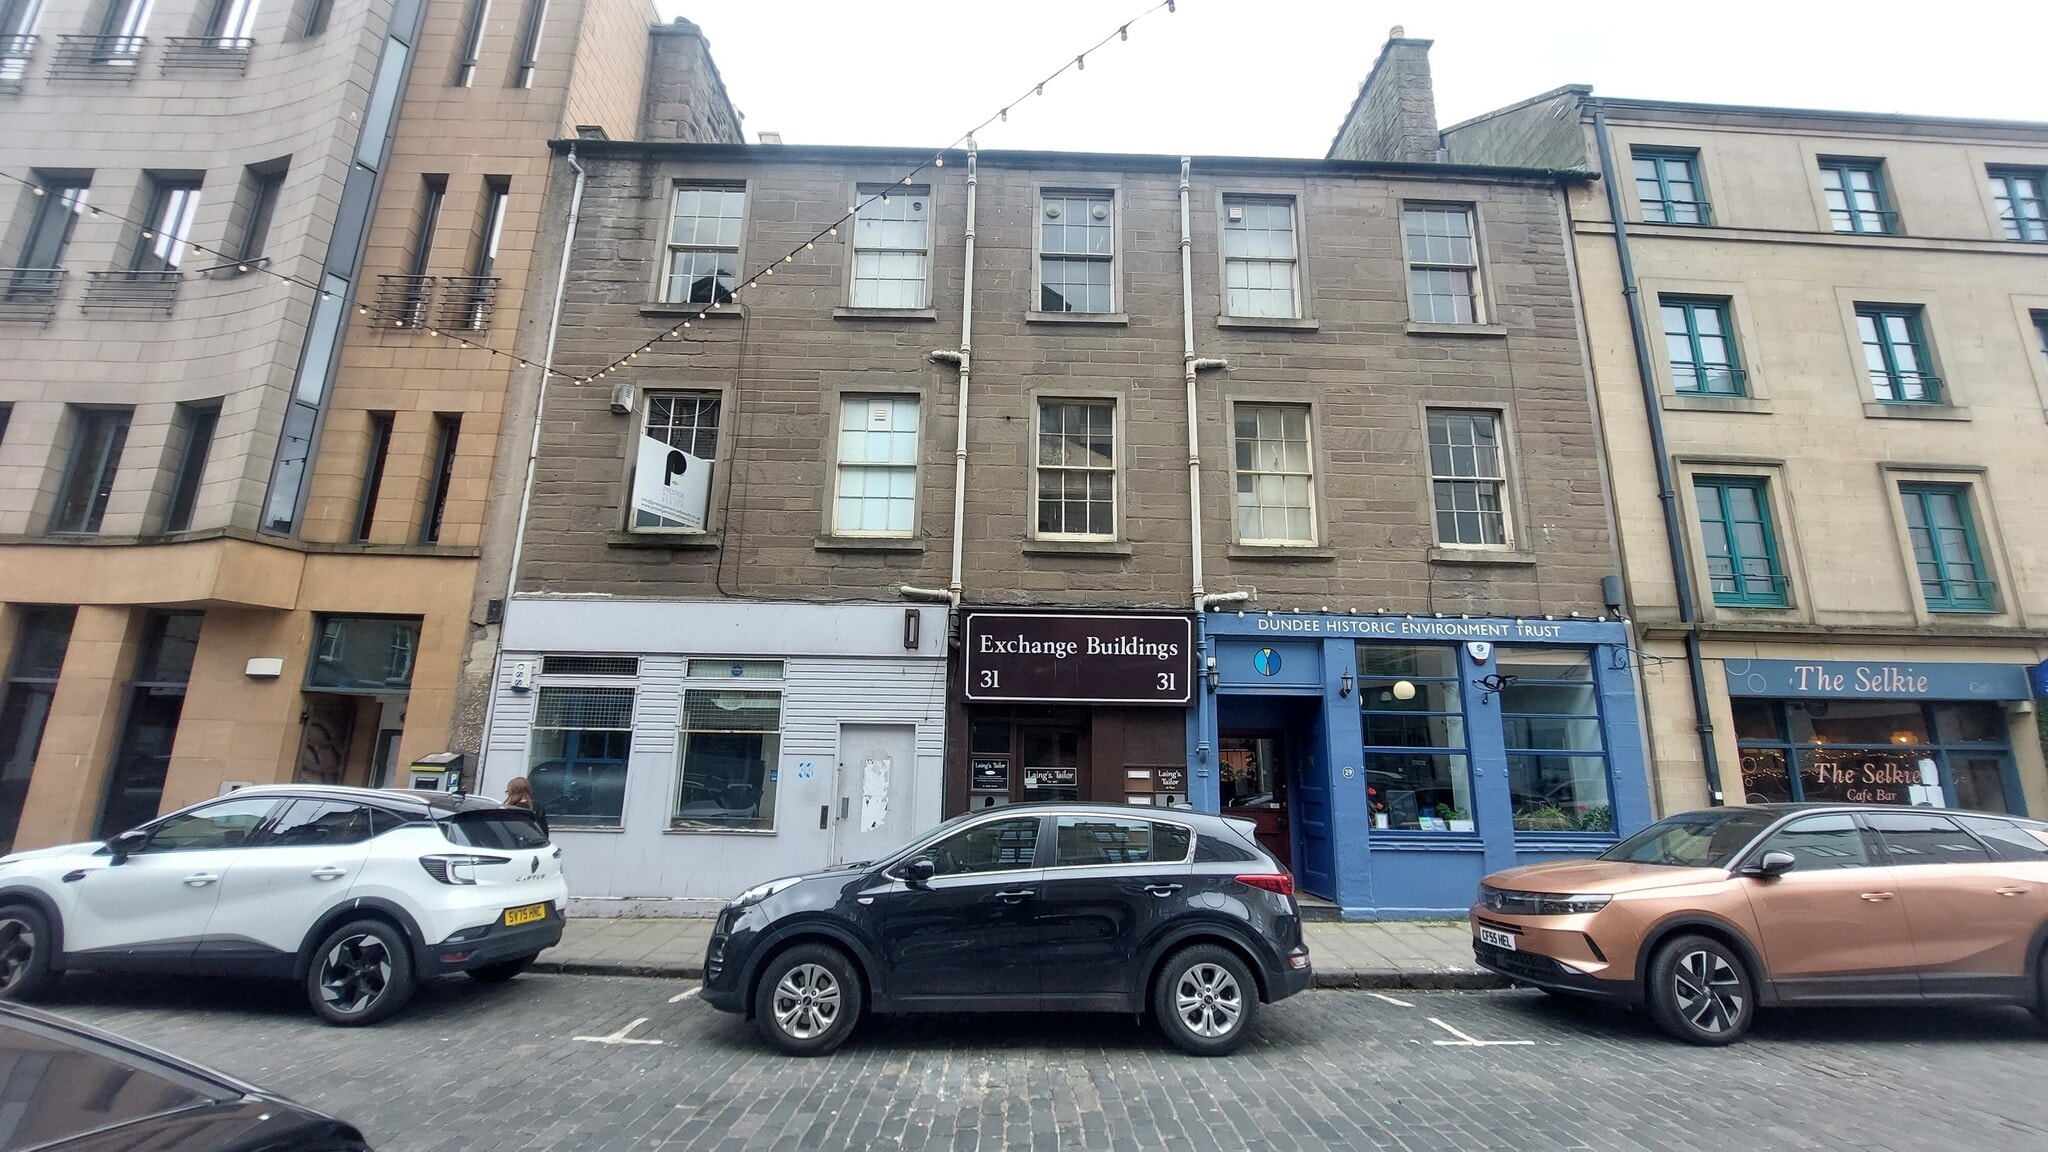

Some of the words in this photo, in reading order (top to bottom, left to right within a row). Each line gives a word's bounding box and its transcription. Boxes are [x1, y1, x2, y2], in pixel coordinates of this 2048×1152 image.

[1258, 619, 1320, 632] DUNDEE
[1326, 620, 1396, 634] HISTORIC
[1402, 622, 1509, 636] ENVIRONMENT
[1515, 625, 1561, 637] TRUST
[980, 634, 1078, 658] Exchange
[1086, 636, 1178, 660] Buildings
[980, 670, 1000, 688] 31
[1156, 673, 1176, 691] 31
[1794, 666, 1844, 691] The
[1854, 666, 1928, 693] Selkie
[1054, 770, 1074, 779] Tailor
[1814, 763, 1854, 783] The
[1862, 763, 1921, 785] Selkie
[1847, 788, 1872, 802] Cafe
[1877, 788, 1897, 801] Bar
[508, 909, 528, 922] SY75
[1482, 929, 1498, 943] CF55
[1498, 933, 1512, 947] HEL
